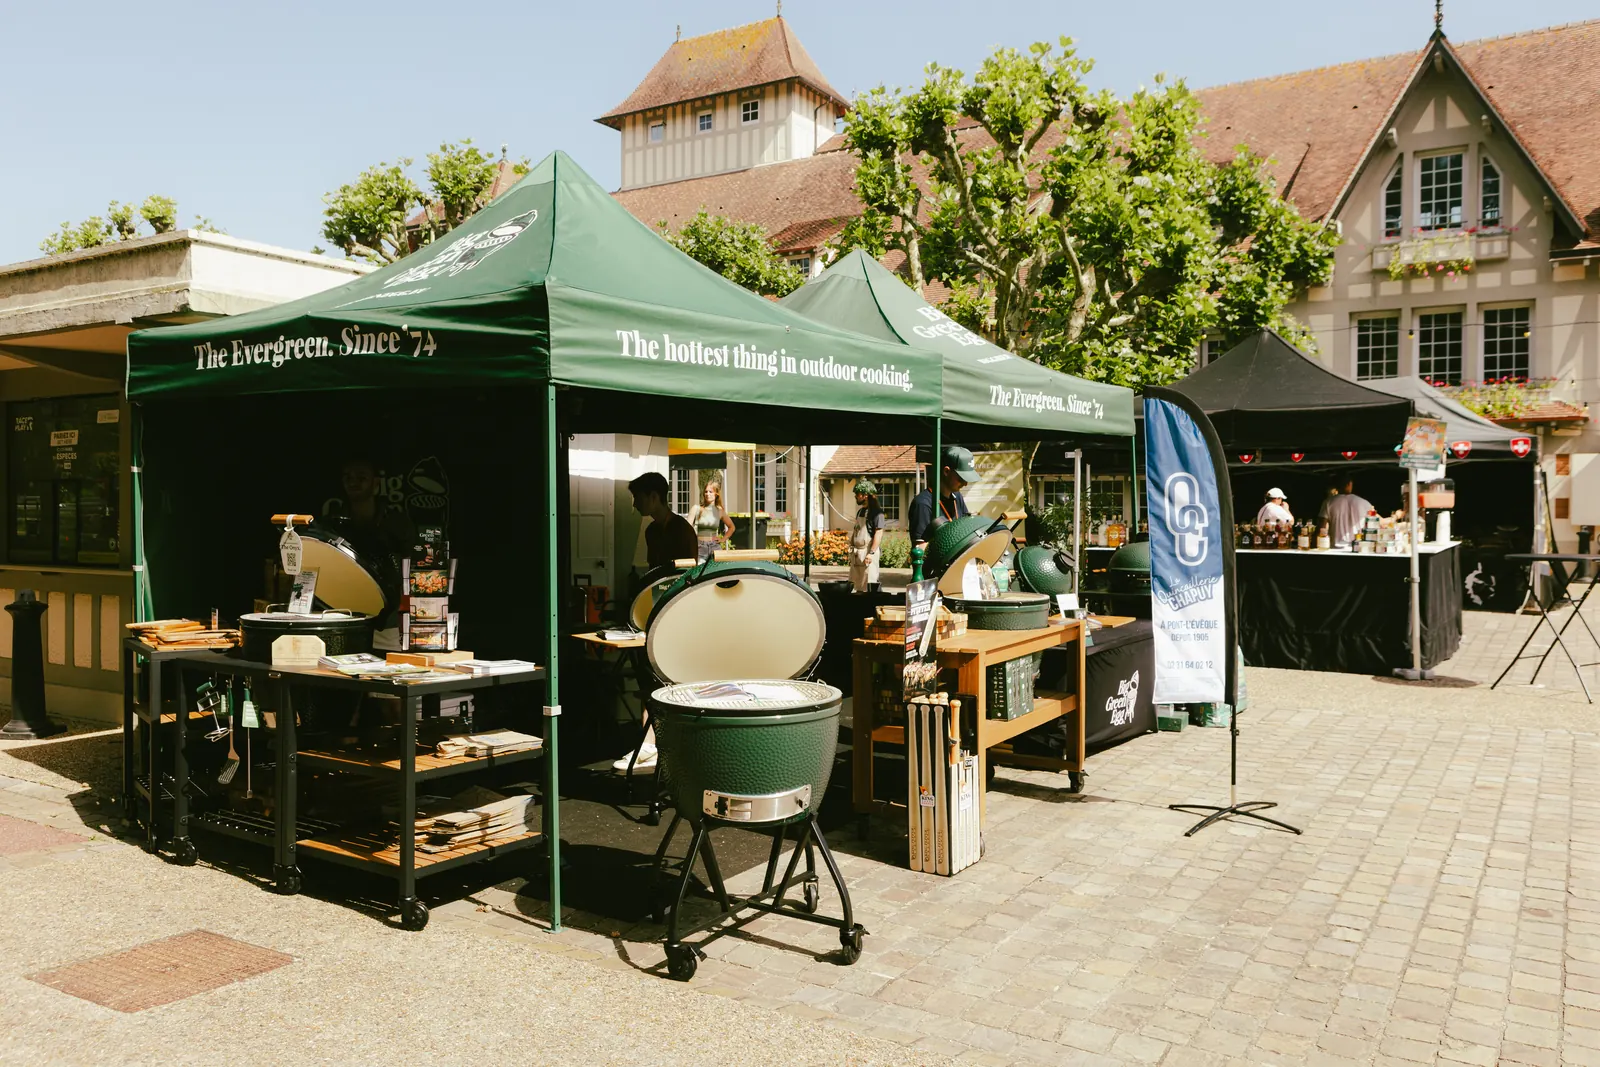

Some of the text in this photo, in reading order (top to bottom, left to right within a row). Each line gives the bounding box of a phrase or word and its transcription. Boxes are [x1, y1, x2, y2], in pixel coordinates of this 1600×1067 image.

[917, 306, 946, 322] Bi
[194, 324, 437, 370] The Evergreen. Since '74
[616, 330, 913, 392] The hottest thing in outdoor cooking.
[990, 385, 1011, 406] The
[1013, 387, 1065, 413] Evergreen.
[1067, 394, 1092, 415] Since
[1168, 584, 1213, 611] CHAPUY
[1185, 660, 1194, 669] 64
[1205, 660, 1213, 669] 12
[1117, 679, 1131, 696] Big
[1105, 696, 1126, 712] Green
[1110, 709, 1125, 726] Egg
